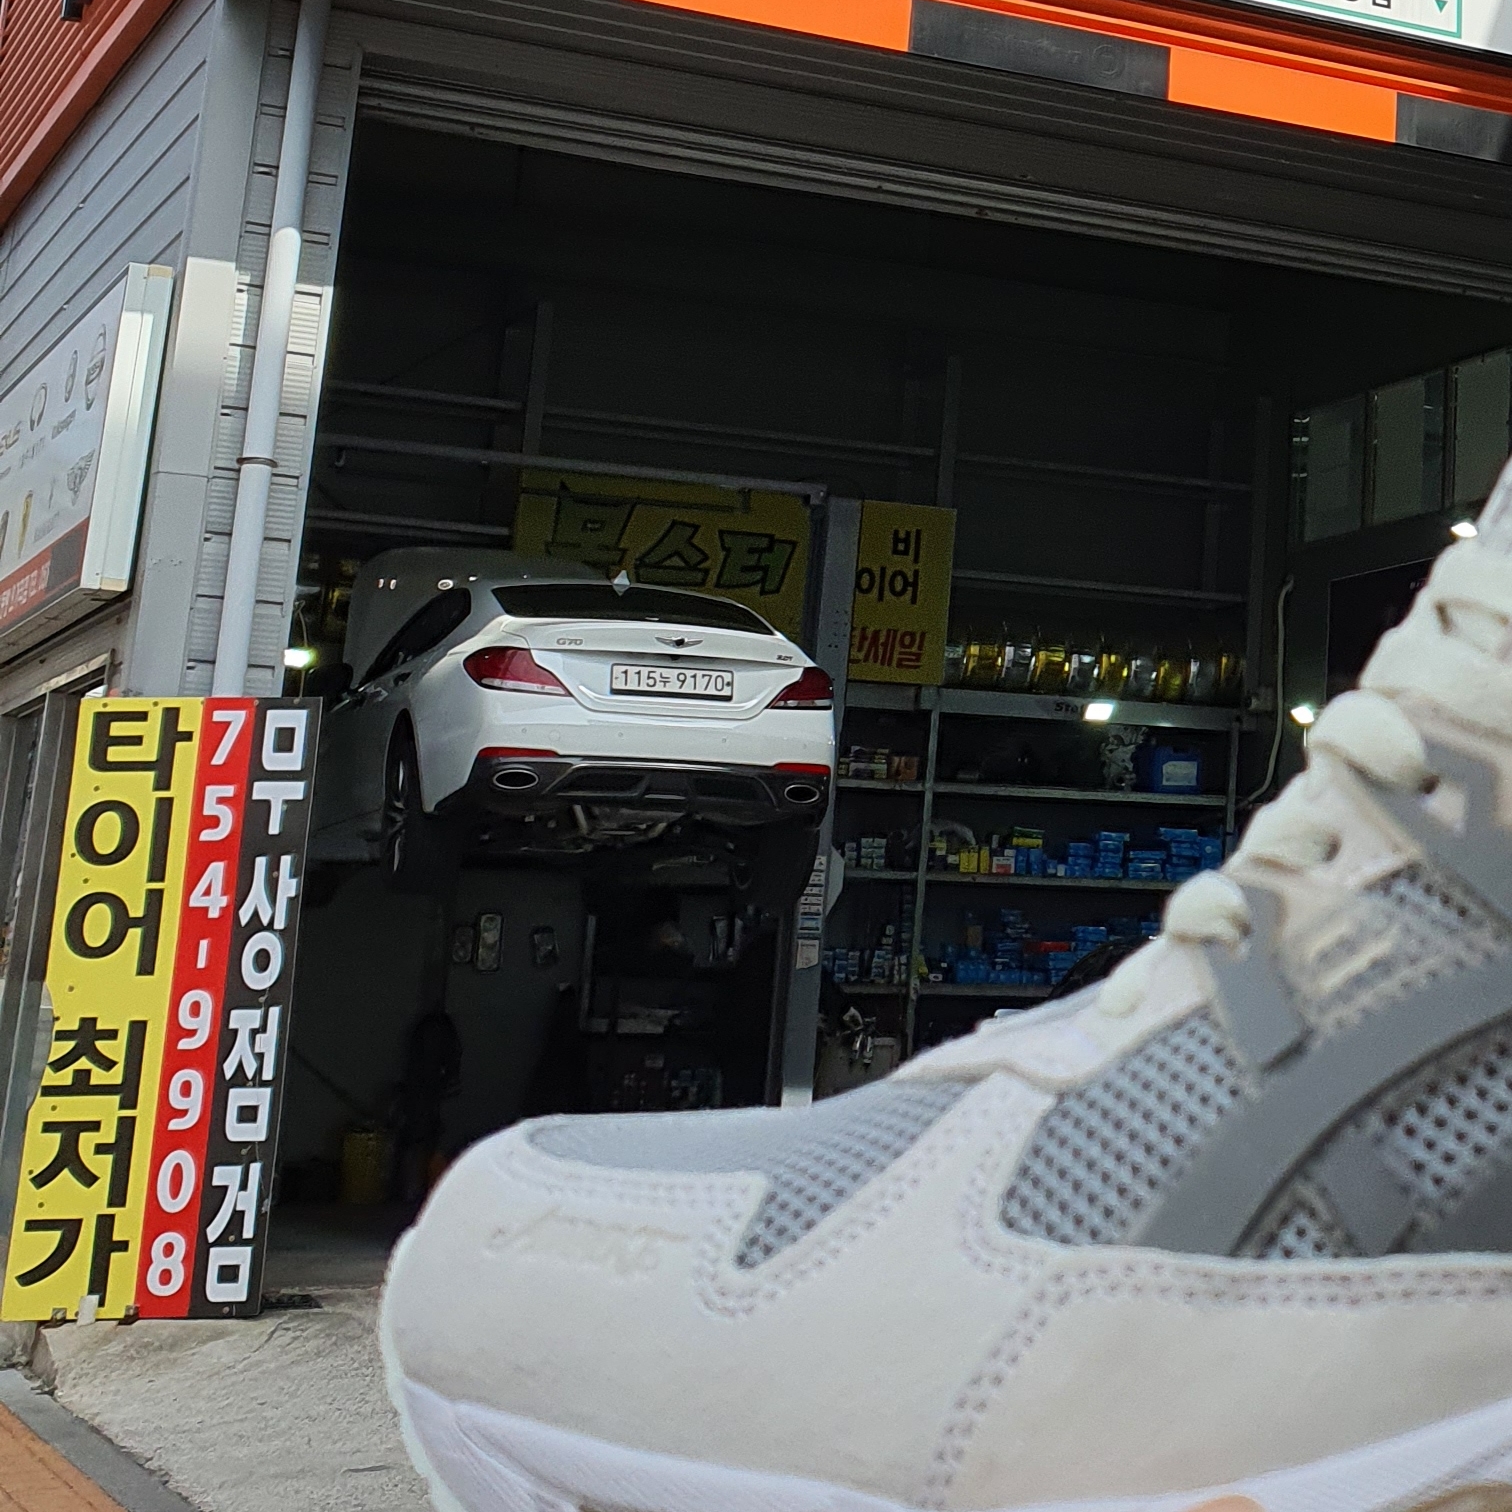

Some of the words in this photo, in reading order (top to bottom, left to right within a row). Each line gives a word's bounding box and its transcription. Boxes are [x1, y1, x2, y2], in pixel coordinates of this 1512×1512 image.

[556, 637, 583, 646] G70
[64, 705, 194, 977] 타이어
[145, 710, 246, 1298] 754-9908
[15, 1017, 148, 1308] 최저가
